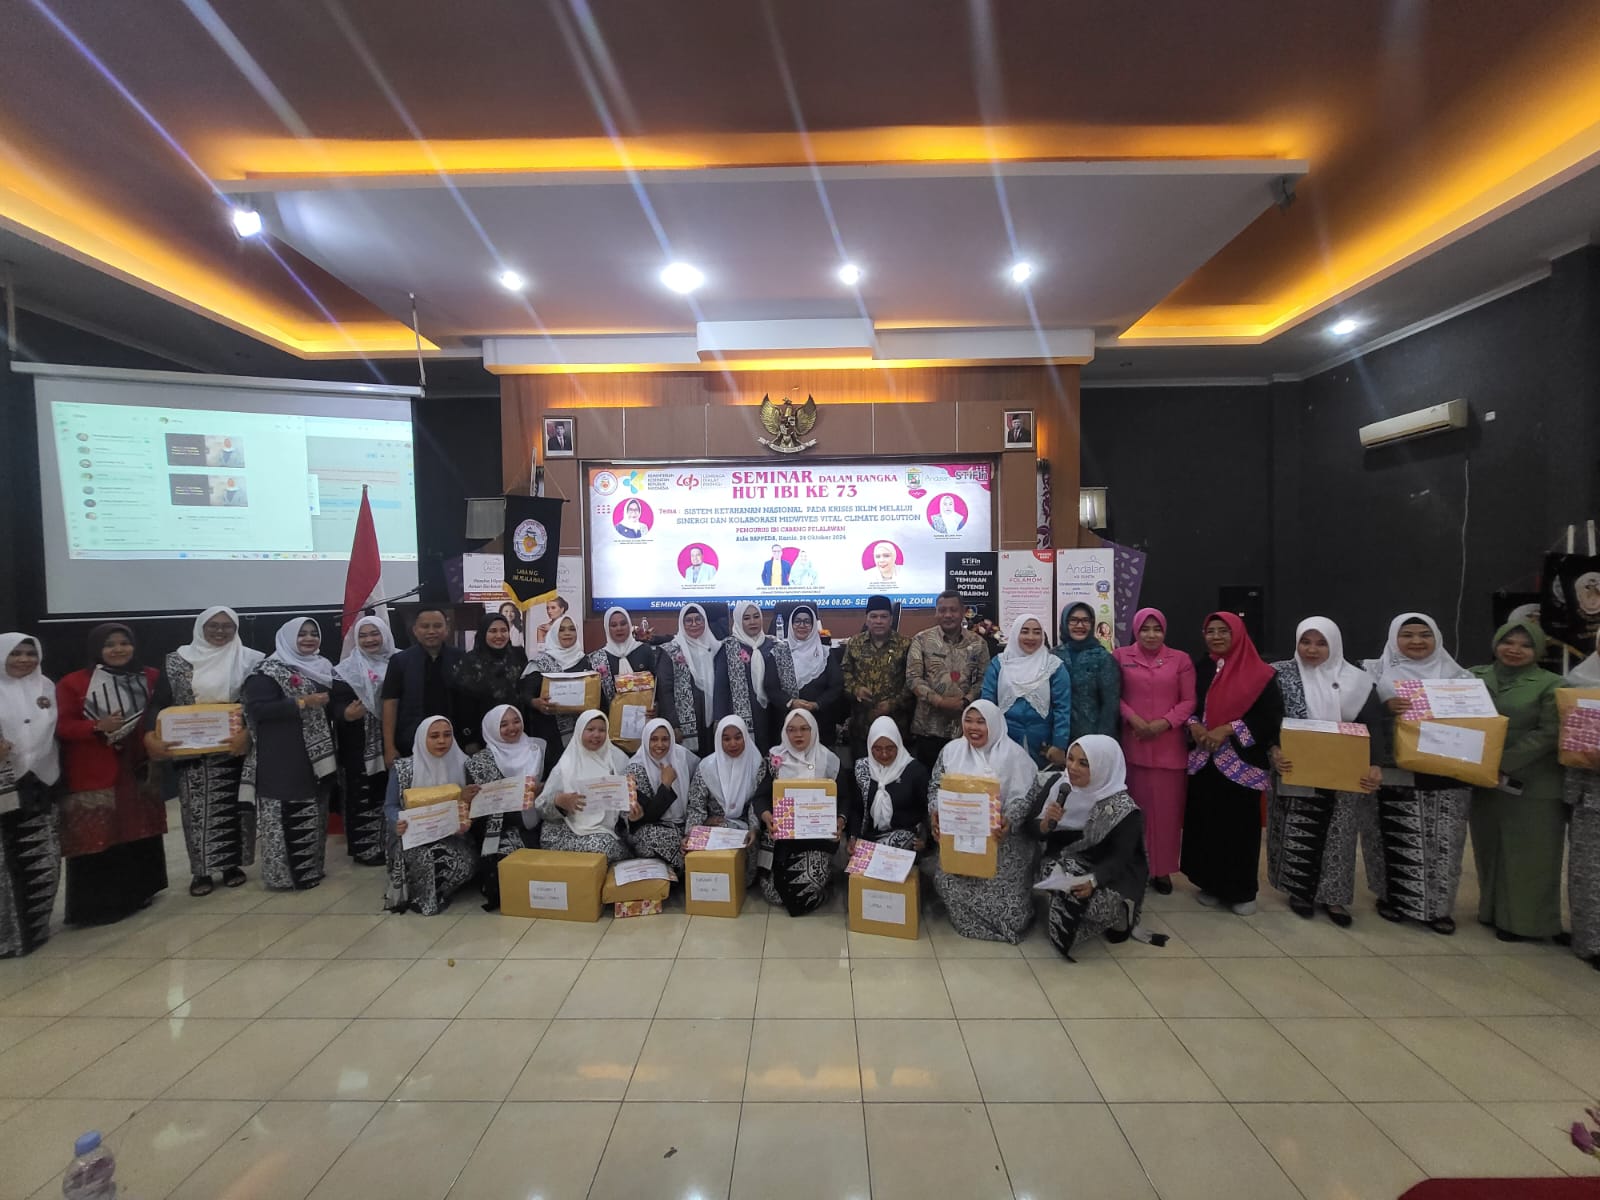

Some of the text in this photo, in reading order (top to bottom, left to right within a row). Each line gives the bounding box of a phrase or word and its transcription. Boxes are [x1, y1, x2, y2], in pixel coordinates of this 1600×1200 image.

[731, 470, 898, 484] SEMINAR DALAM RANGKA
[732, 484, 858, 499] HUT IBI KE 73
[763, 506, 803, 514] NASIONAL
[807, 505, 827, 513] PADA
[879, 504, 913, 512] MELALUI
[728, 516, 777, 524] KOLABORASI
[779, 515, 819, 523] MIDWIVES
[844, 514, 879, 522] CLIMATE
[880, 513, 921, 521] SOLUTION
[909, 597, 933, 605] ZOOM
[1100, 604, 1109, 614] 3
